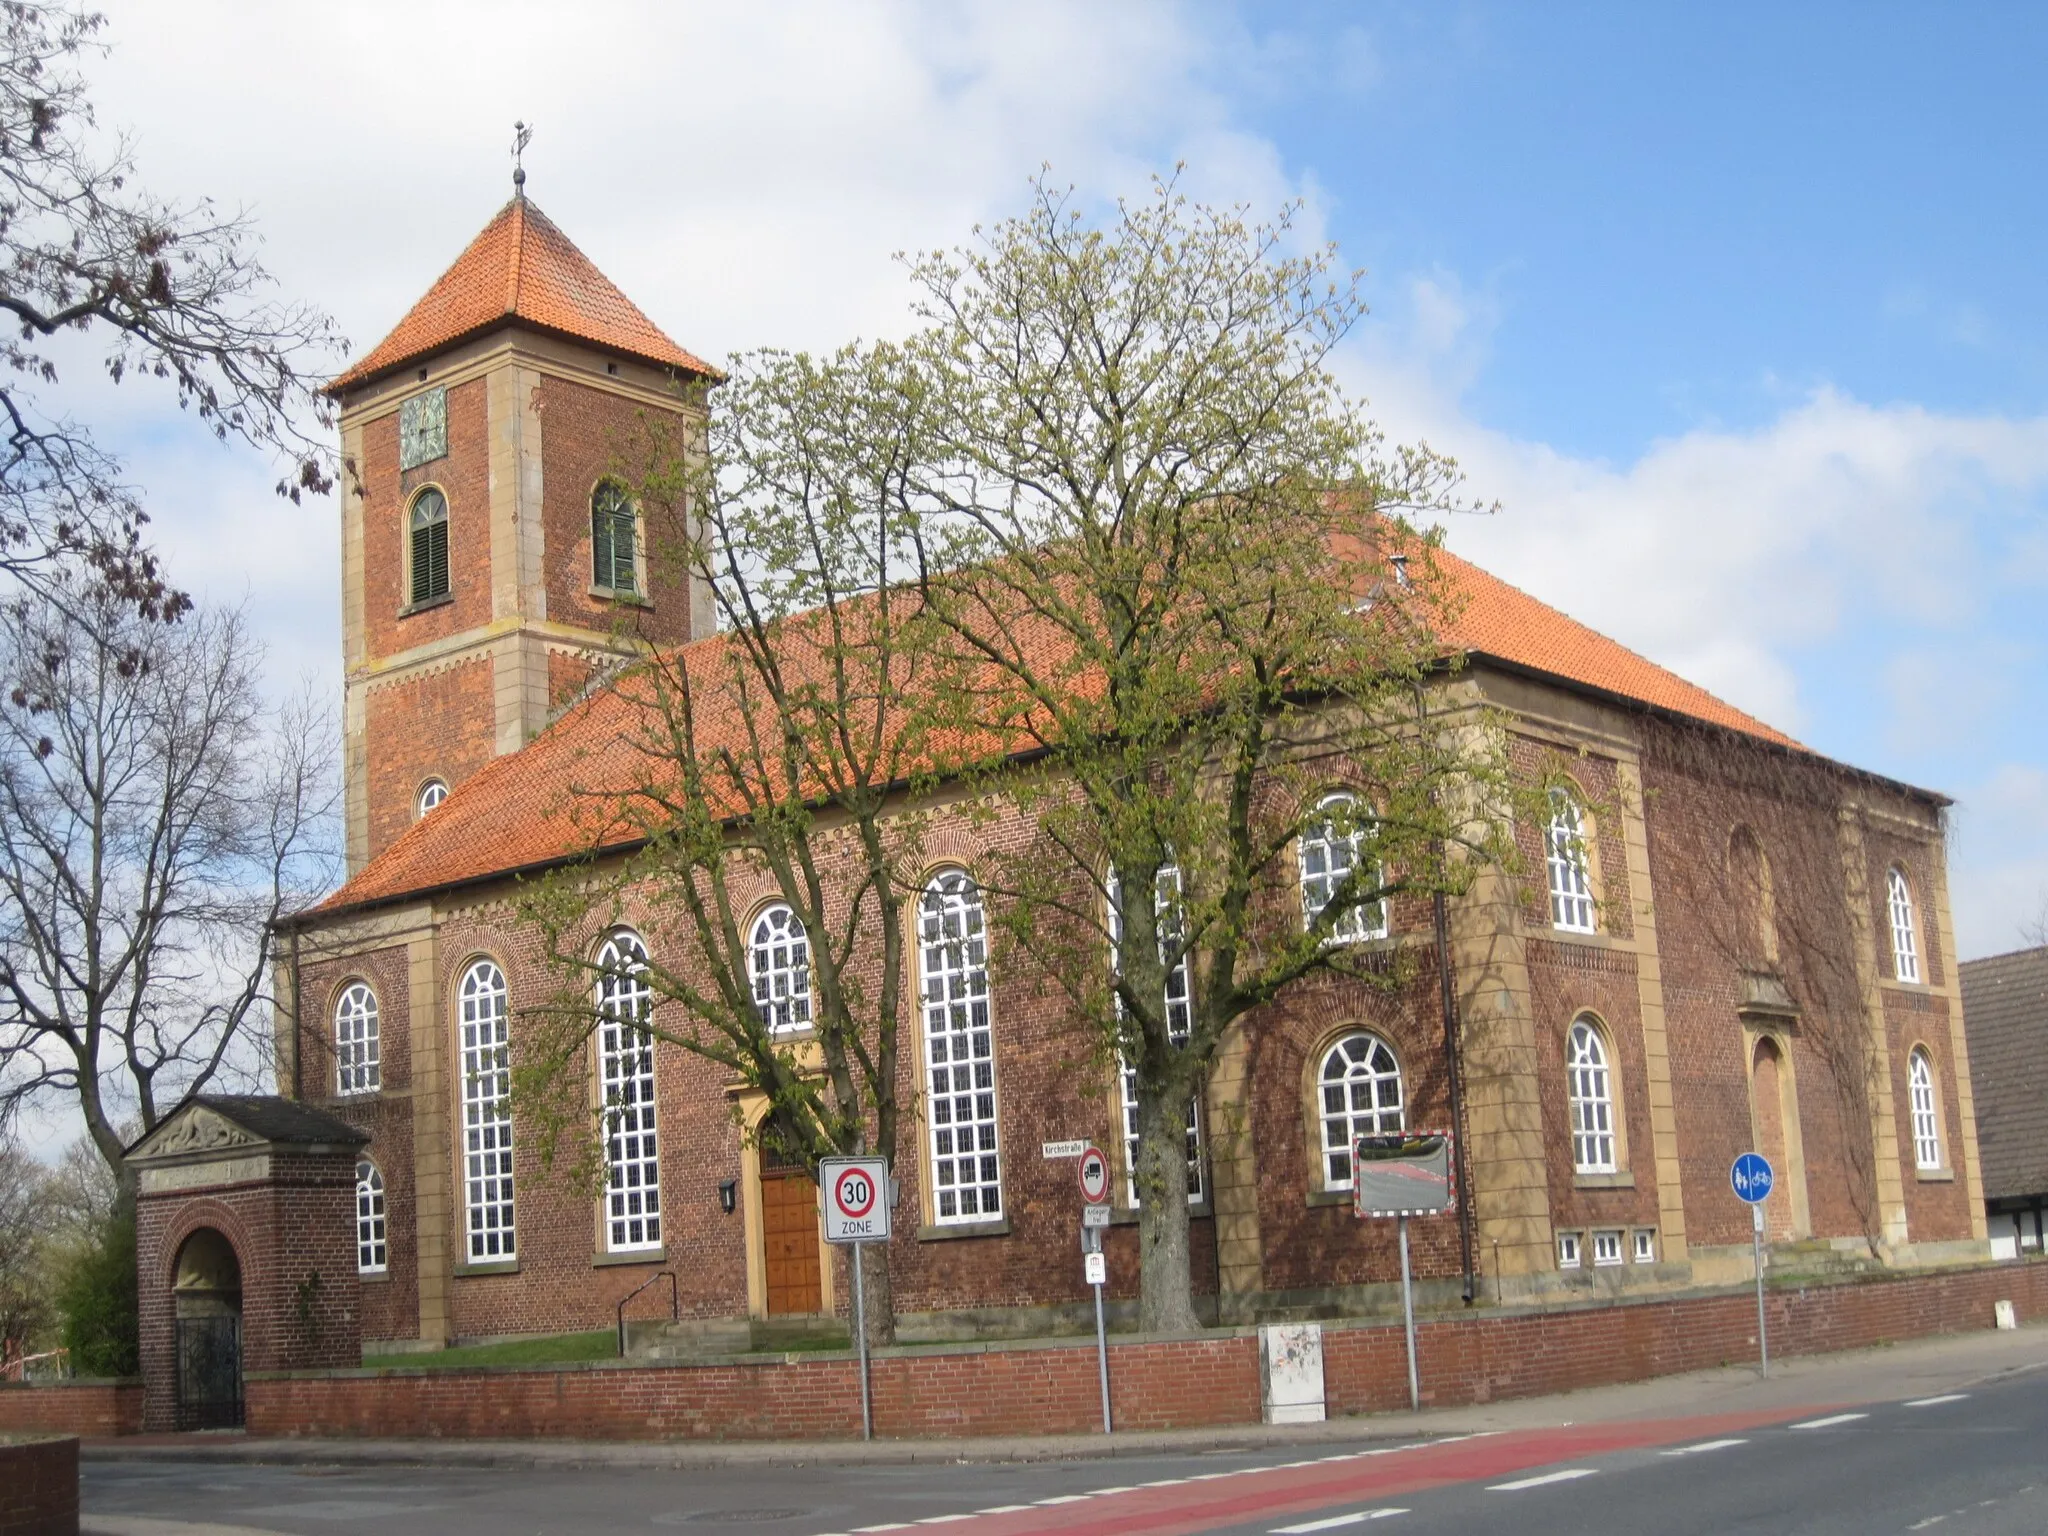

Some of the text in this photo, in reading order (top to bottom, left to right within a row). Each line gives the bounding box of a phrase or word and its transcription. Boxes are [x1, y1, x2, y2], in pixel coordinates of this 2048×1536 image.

[1045, 1143, 1081, 1154] Kirchstraße
[844, 1182, 867, 1204] 30
[842, 1220, 872, 1234] ZONE
